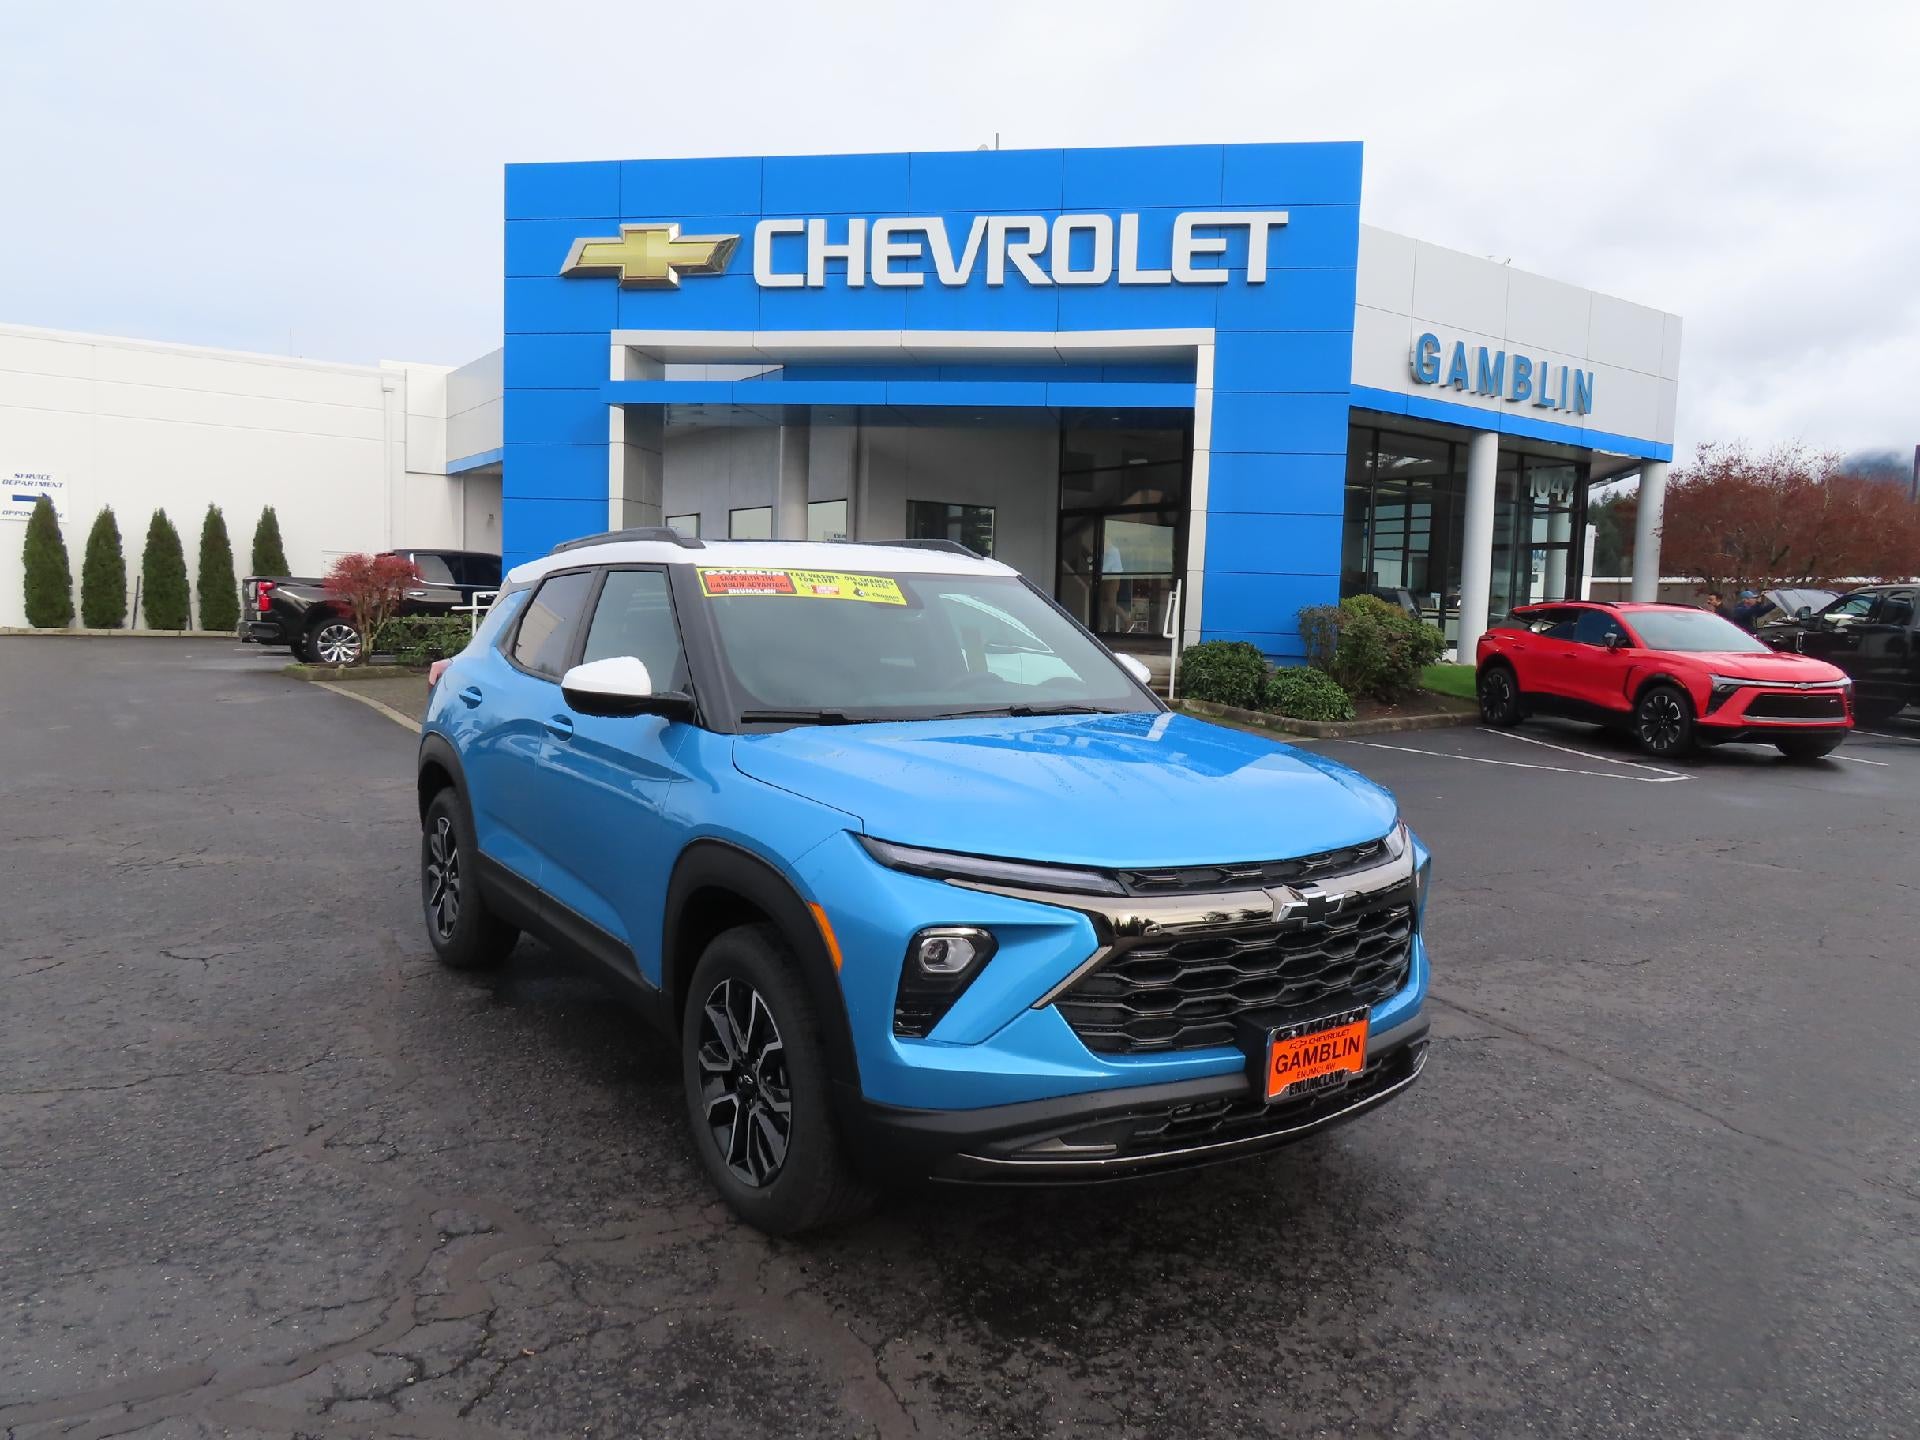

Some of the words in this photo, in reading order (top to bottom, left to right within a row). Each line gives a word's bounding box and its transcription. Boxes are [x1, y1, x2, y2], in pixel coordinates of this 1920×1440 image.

[753, 211, 1289, 288] CHEVROLET
[1411, 332, 1594, 416] GAMBLIN
[2, 479, 64, 488] DEPARTMENT
[1528, 465, 1577, 504] 1047
[1275, 1008, 1368, 1040] GAMBLIN
[1309, 1029, 1350, 1044] CHEVROLET
[1275, 1035, 1361, 1074] GAMBLIN
[1296, 1062, 1336, 1079] ENUMCLAW
[1289, 1069, 1346, 1096] ENUMCLAW
